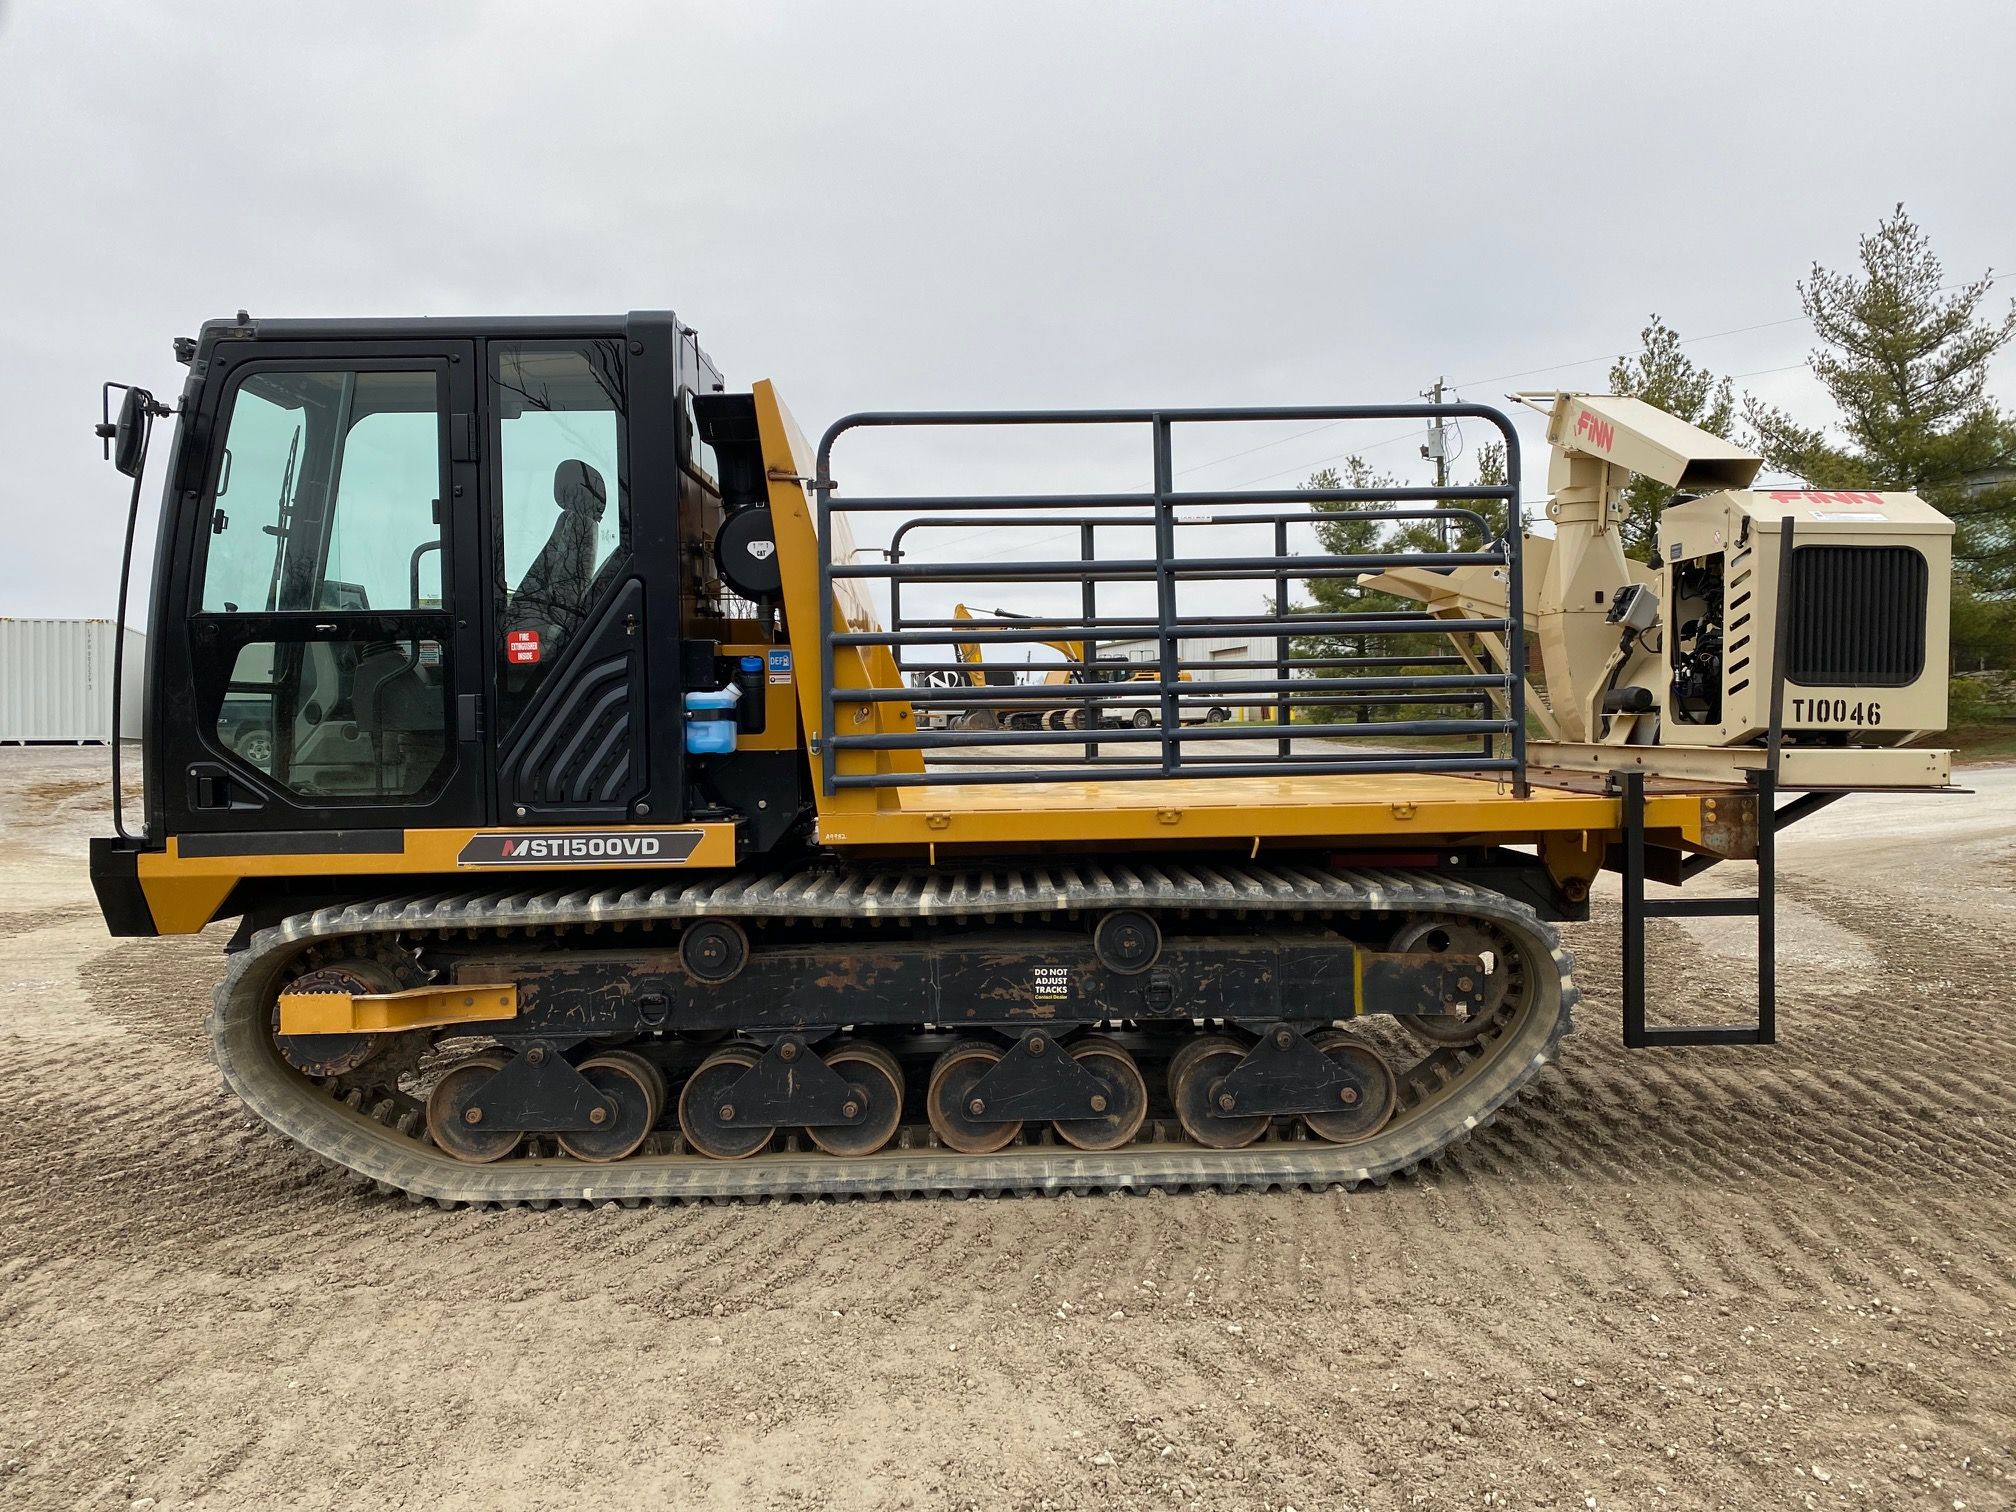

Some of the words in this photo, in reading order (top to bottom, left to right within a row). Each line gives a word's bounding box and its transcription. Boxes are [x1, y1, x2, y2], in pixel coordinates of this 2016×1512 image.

[518, 632, 530, 641] FIRE
[517, 652, 534, 660] INSIDE
[770, 656, 783, 666] DEF
[1034, 968, 1048, 976] DO
[1049, 968, 1068, 976] NOT
[1035, 977, 1068, 985] ADJUST
[1034, 986, 1068, 994] TRACKS
